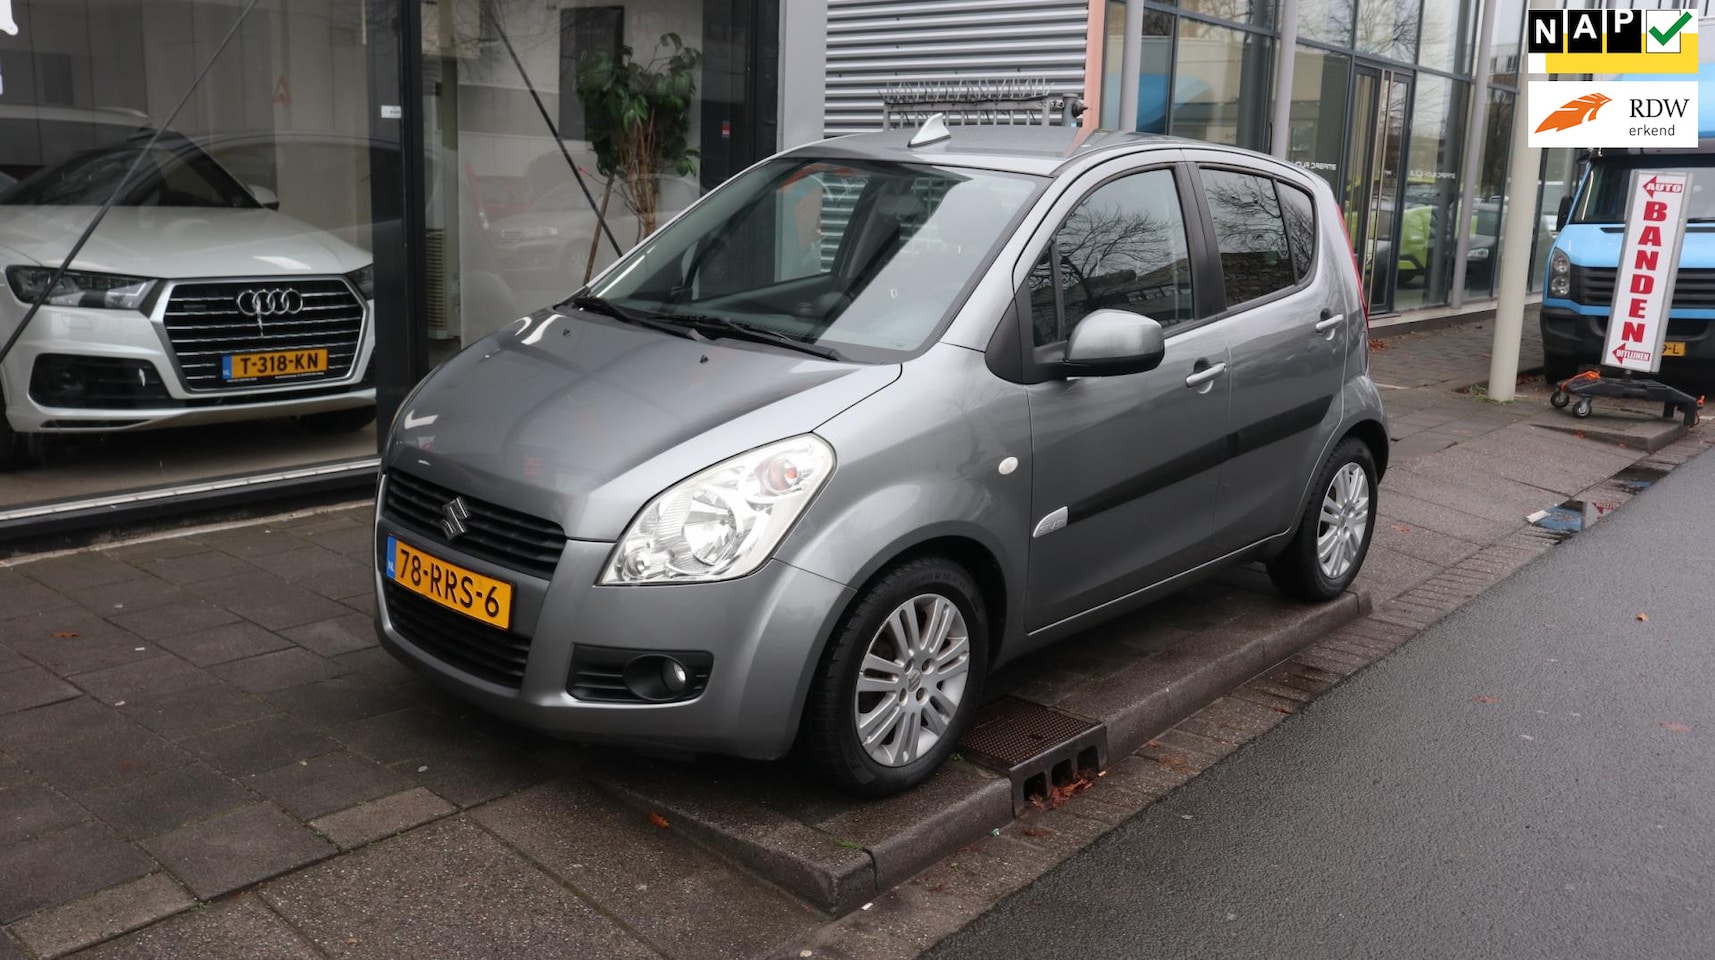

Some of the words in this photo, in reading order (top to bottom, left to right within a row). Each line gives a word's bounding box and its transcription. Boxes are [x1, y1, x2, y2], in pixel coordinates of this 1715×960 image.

[1646, 183, 1682, 192] AUTO
[1621, 201, 1668, 343] BANDEN
[240, 352, 319, 375] T-318-KN
[400, 548, 500, 618] 78-RRS-6
